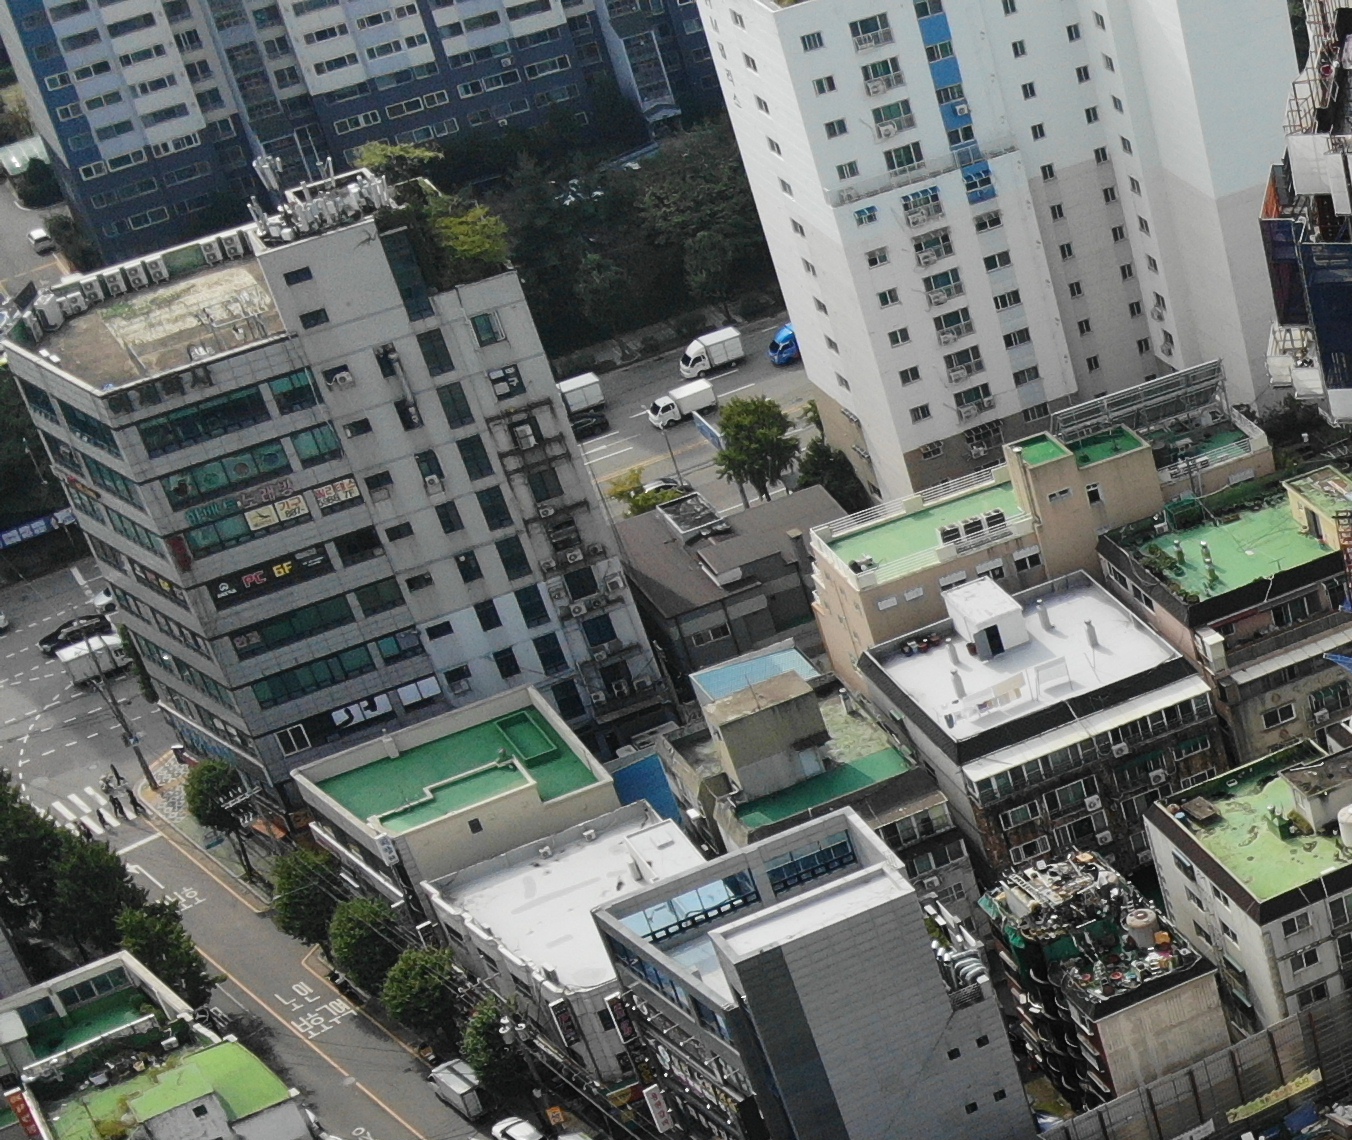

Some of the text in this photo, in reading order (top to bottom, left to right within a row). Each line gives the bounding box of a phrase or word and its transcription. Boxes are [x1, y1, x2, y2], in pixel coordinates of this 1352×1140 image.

[242, 561, 294, 588] PC 6F
[274, 981, 321, 1011] 노인
[290, 998, 358, 1040] 보호구역
